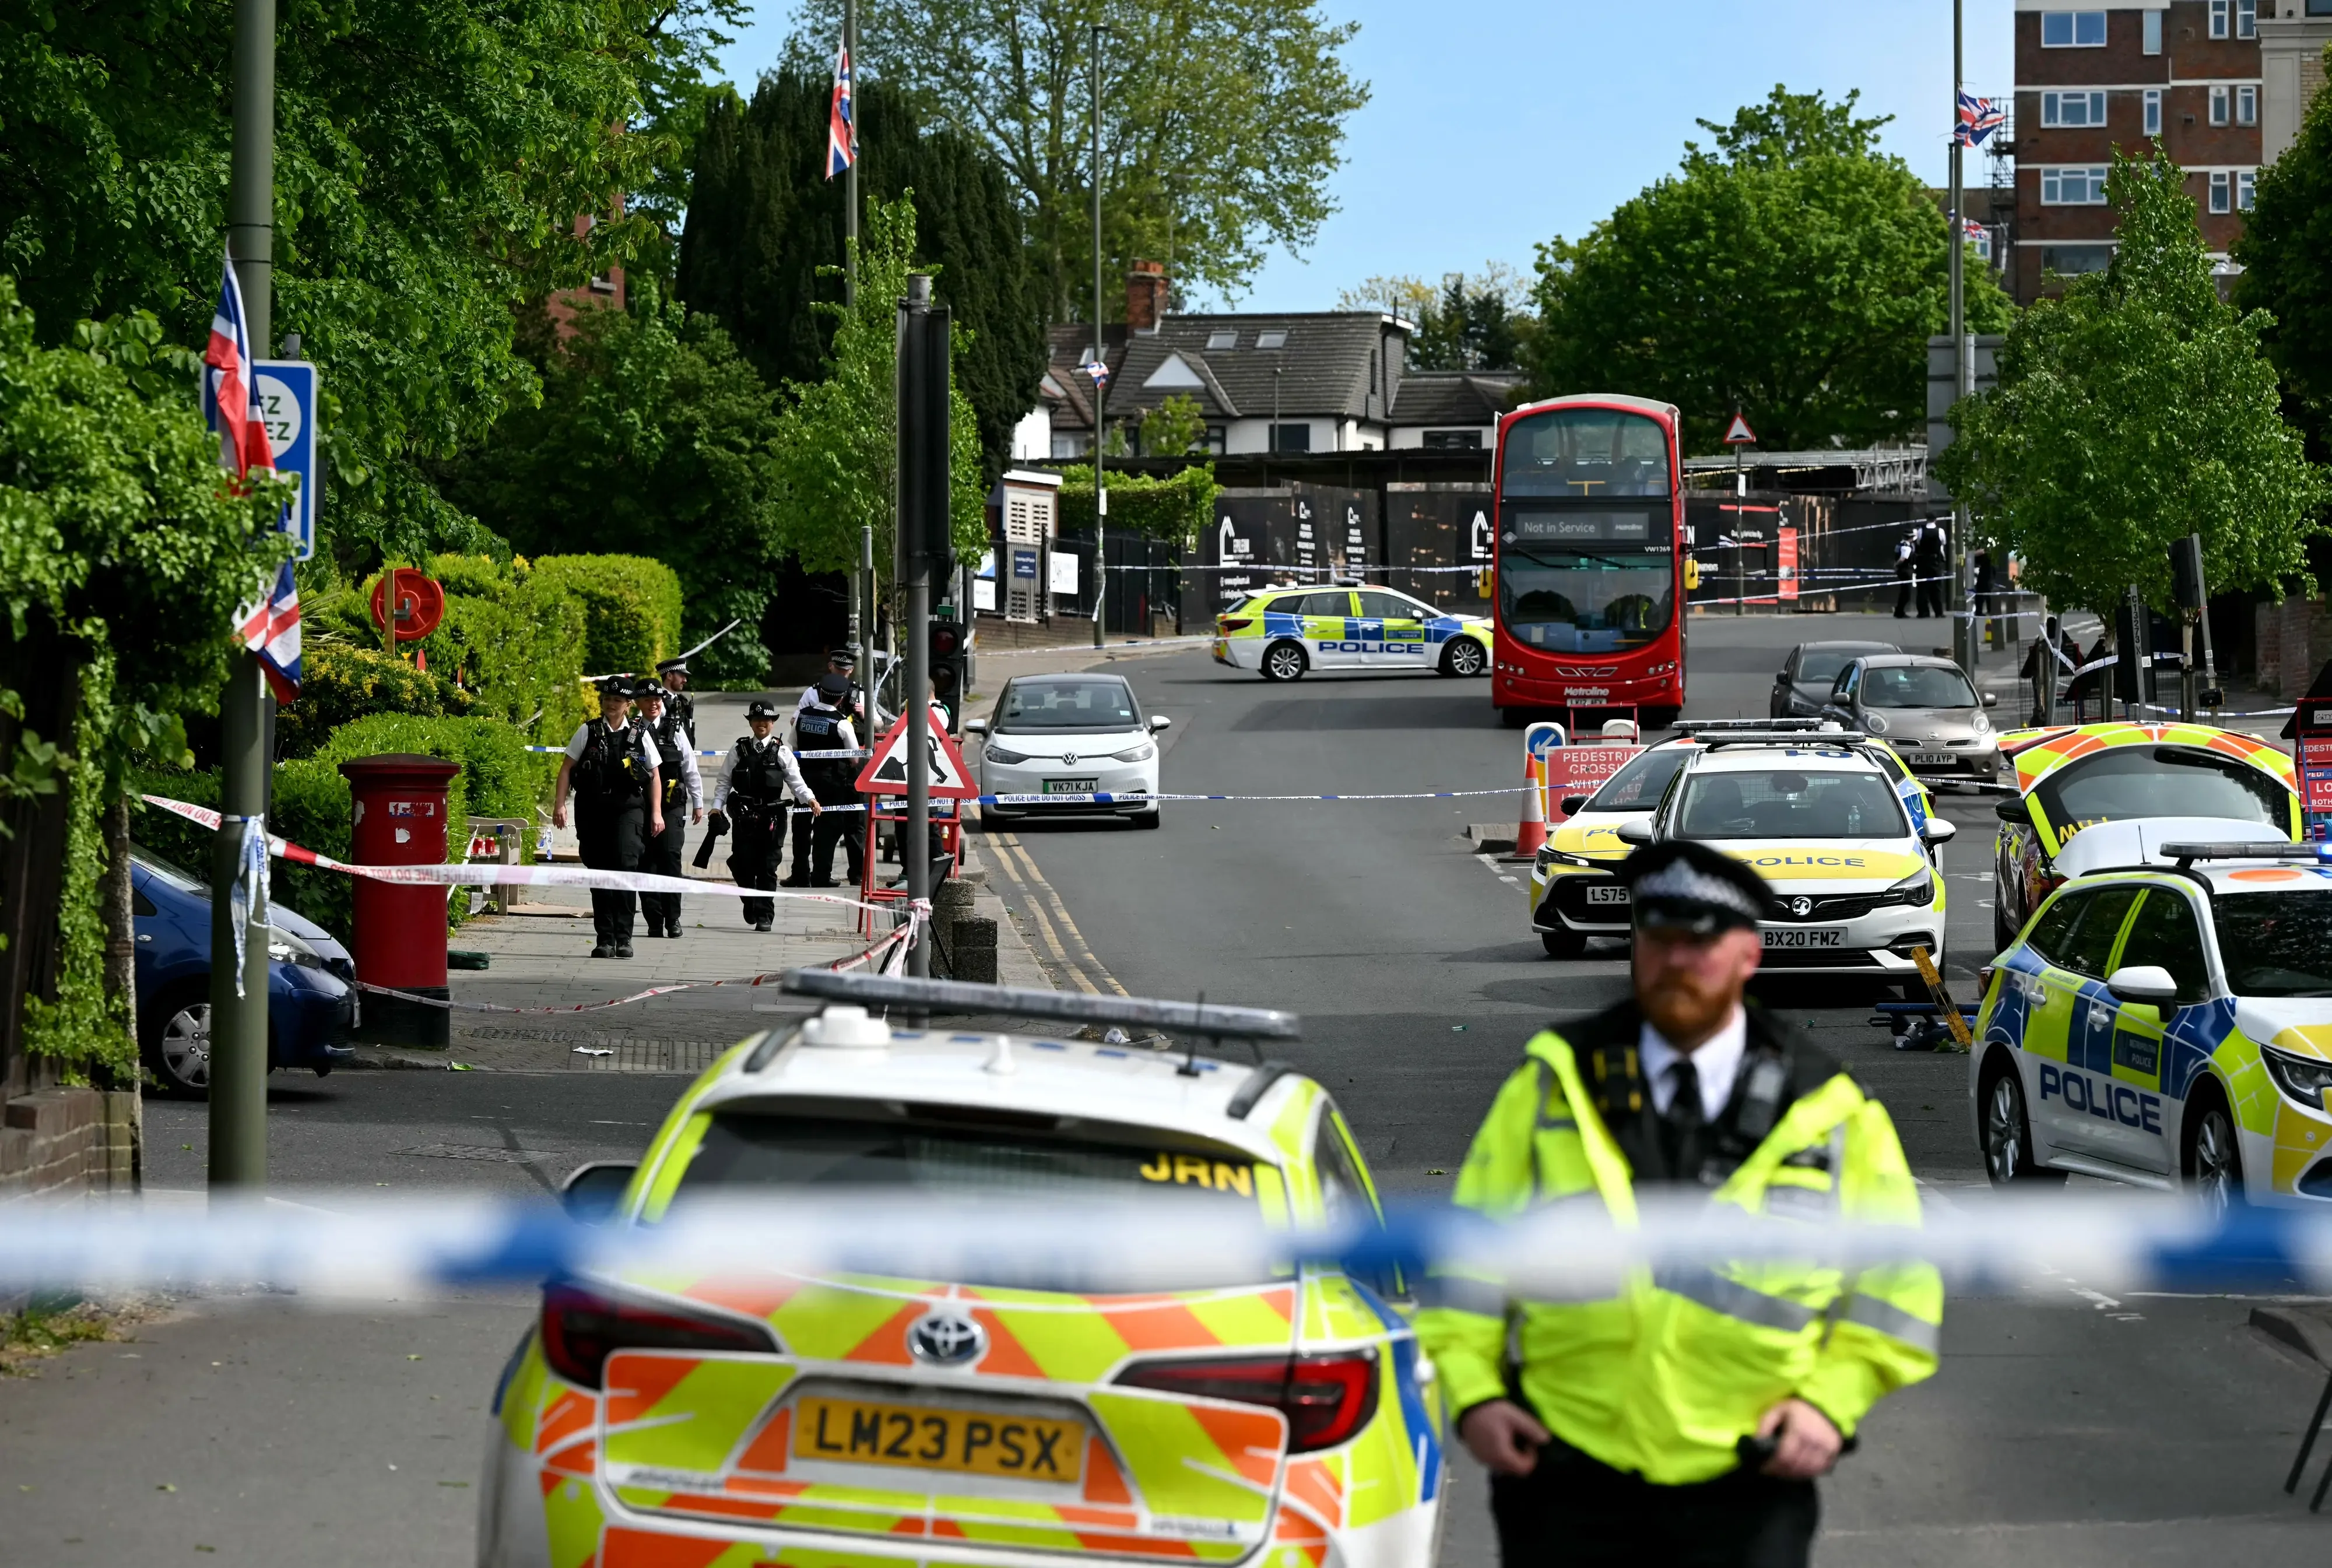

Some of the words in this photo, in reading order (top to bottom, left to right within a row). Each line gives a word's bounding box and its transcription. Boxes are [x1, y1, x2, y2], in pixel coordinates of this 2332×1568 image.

[1525, 522, 1543, 533] Not
[1547, 522, 1556, 533] in
[1559, 522, 1596, 533] Service
[1318, 642, 1424, 653] POLICE
[1564, 686, 1610, 696] Metroline
[801, 723, 827, 733] POLICE
[1563, 751, 1636, 762] PEDESTRIA
[1052, 782, 1073, 791] VK71
[1076, 782, 1094, 791] KJA
[1571, 780, 1601, 789] WHE
[1592, 888, 1627, 901] LS75
[1764, 931, 1805, 946] BX20
[1810, 931, 1840, 946] FMZ
[2131, 1053, 2152, 1068] POLICE
[2040, 1063, 2162, 1136] POLICE
[1140, 1152, 1253, 1198] JRN
[816, 1407, 948, 1461] LM23
[963, 1420, 1062, 1473] PSX
